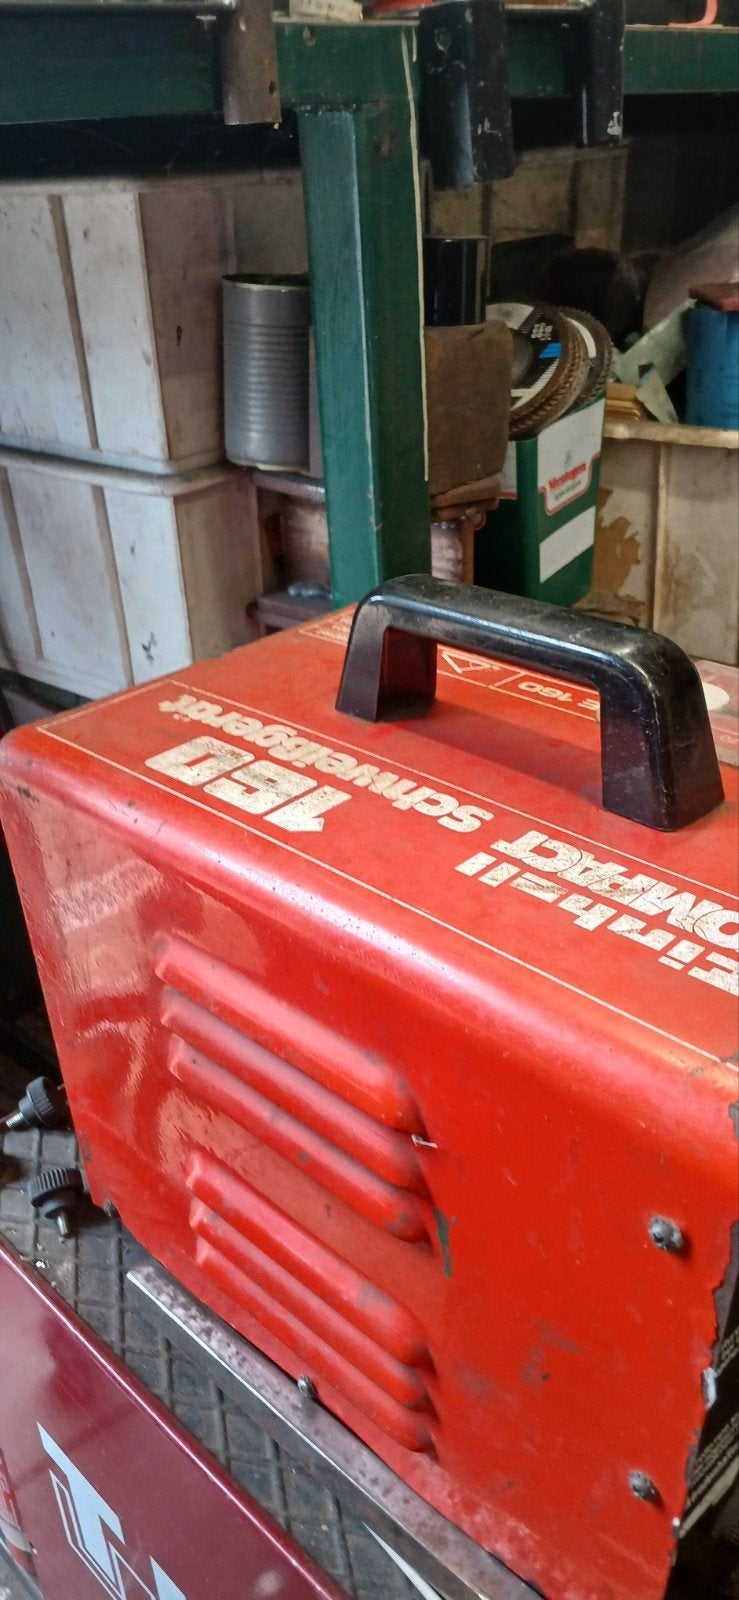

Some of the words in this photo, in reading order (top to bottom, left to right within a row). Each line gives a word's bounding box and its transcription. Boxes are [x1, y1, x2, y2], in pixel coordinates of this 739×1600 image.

[144, 735, 352, 832] 160
[454, 850, 739, 997] Einhell
[490, 829, 739, 953] OMPACT
